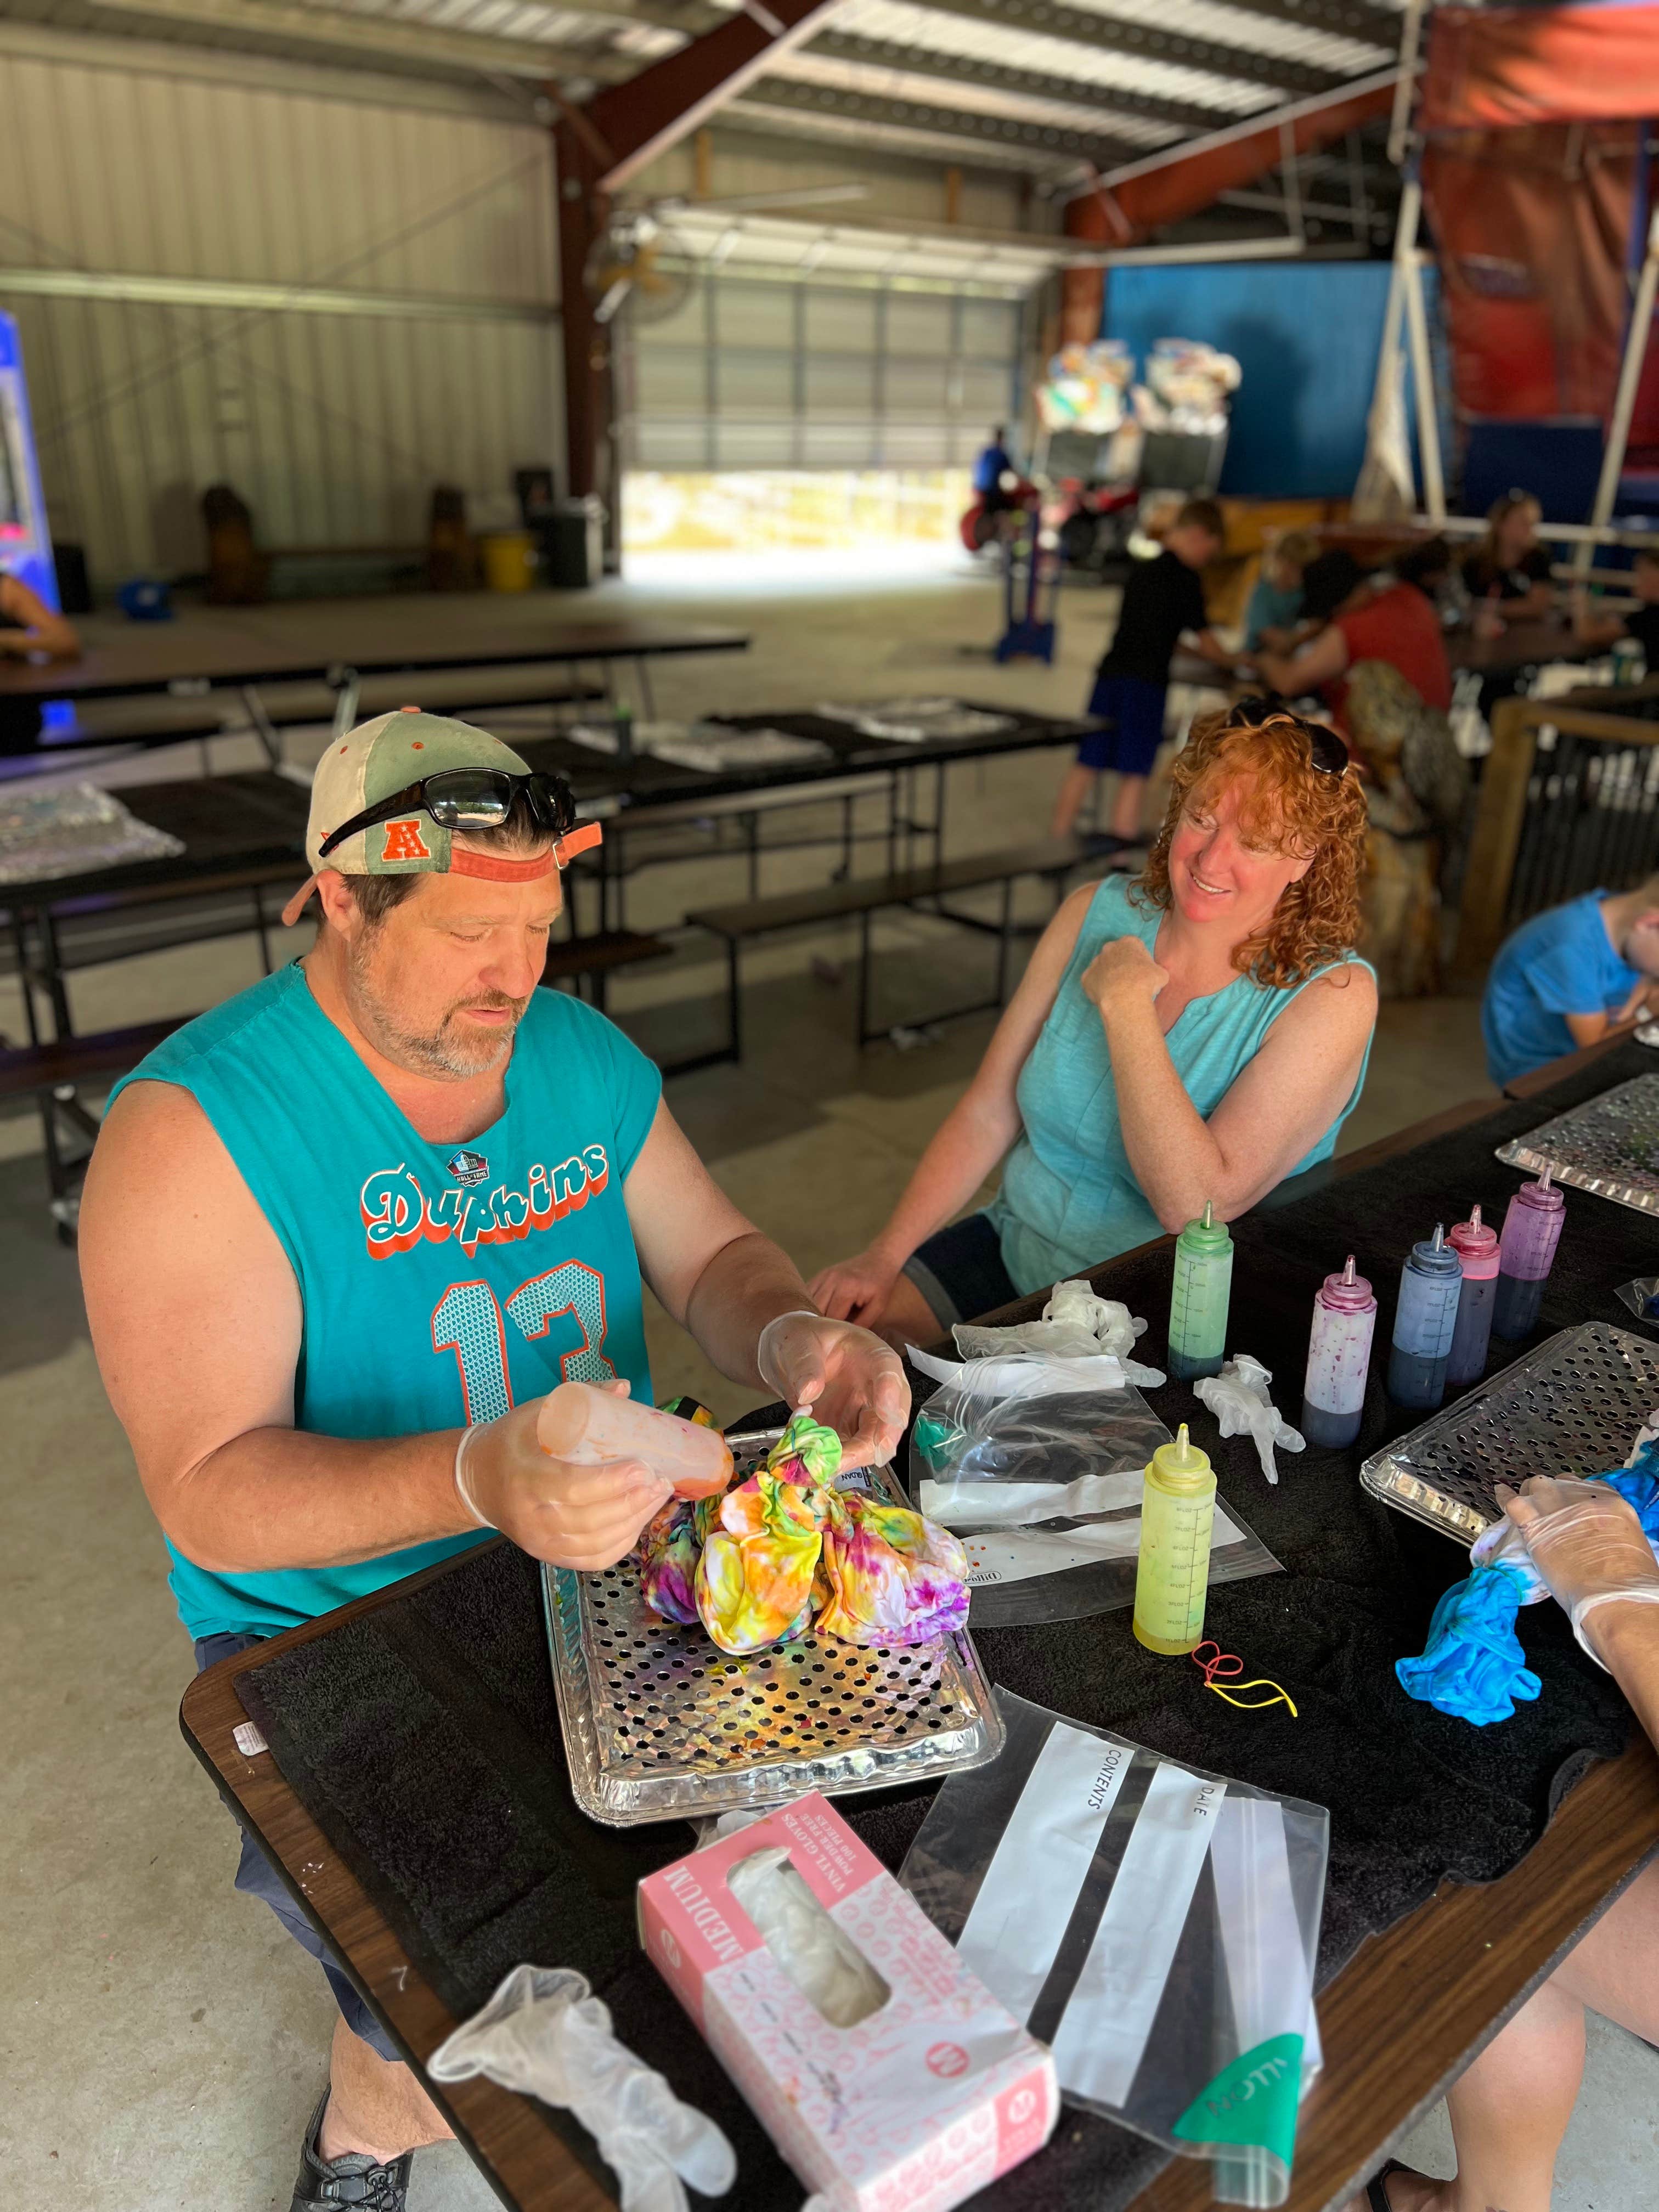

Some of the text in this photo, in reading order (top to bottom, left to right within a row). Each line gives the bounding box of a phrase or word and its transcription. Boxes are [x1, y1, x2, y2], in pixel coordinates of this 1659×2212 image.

[381, 819, 431, 862] A
[473, 1170, 487, 1179] FAME
[1088, 1750, 1122, 1810] CONTENTS
[1193, 1786, 1215, 1816] DATE
[782, 1813, 846, 1893] VINYL GLOVES
[815, 1814, 856, 1861] 100 PIECES
[663, 1865, 745, 1962] MEDIUM
